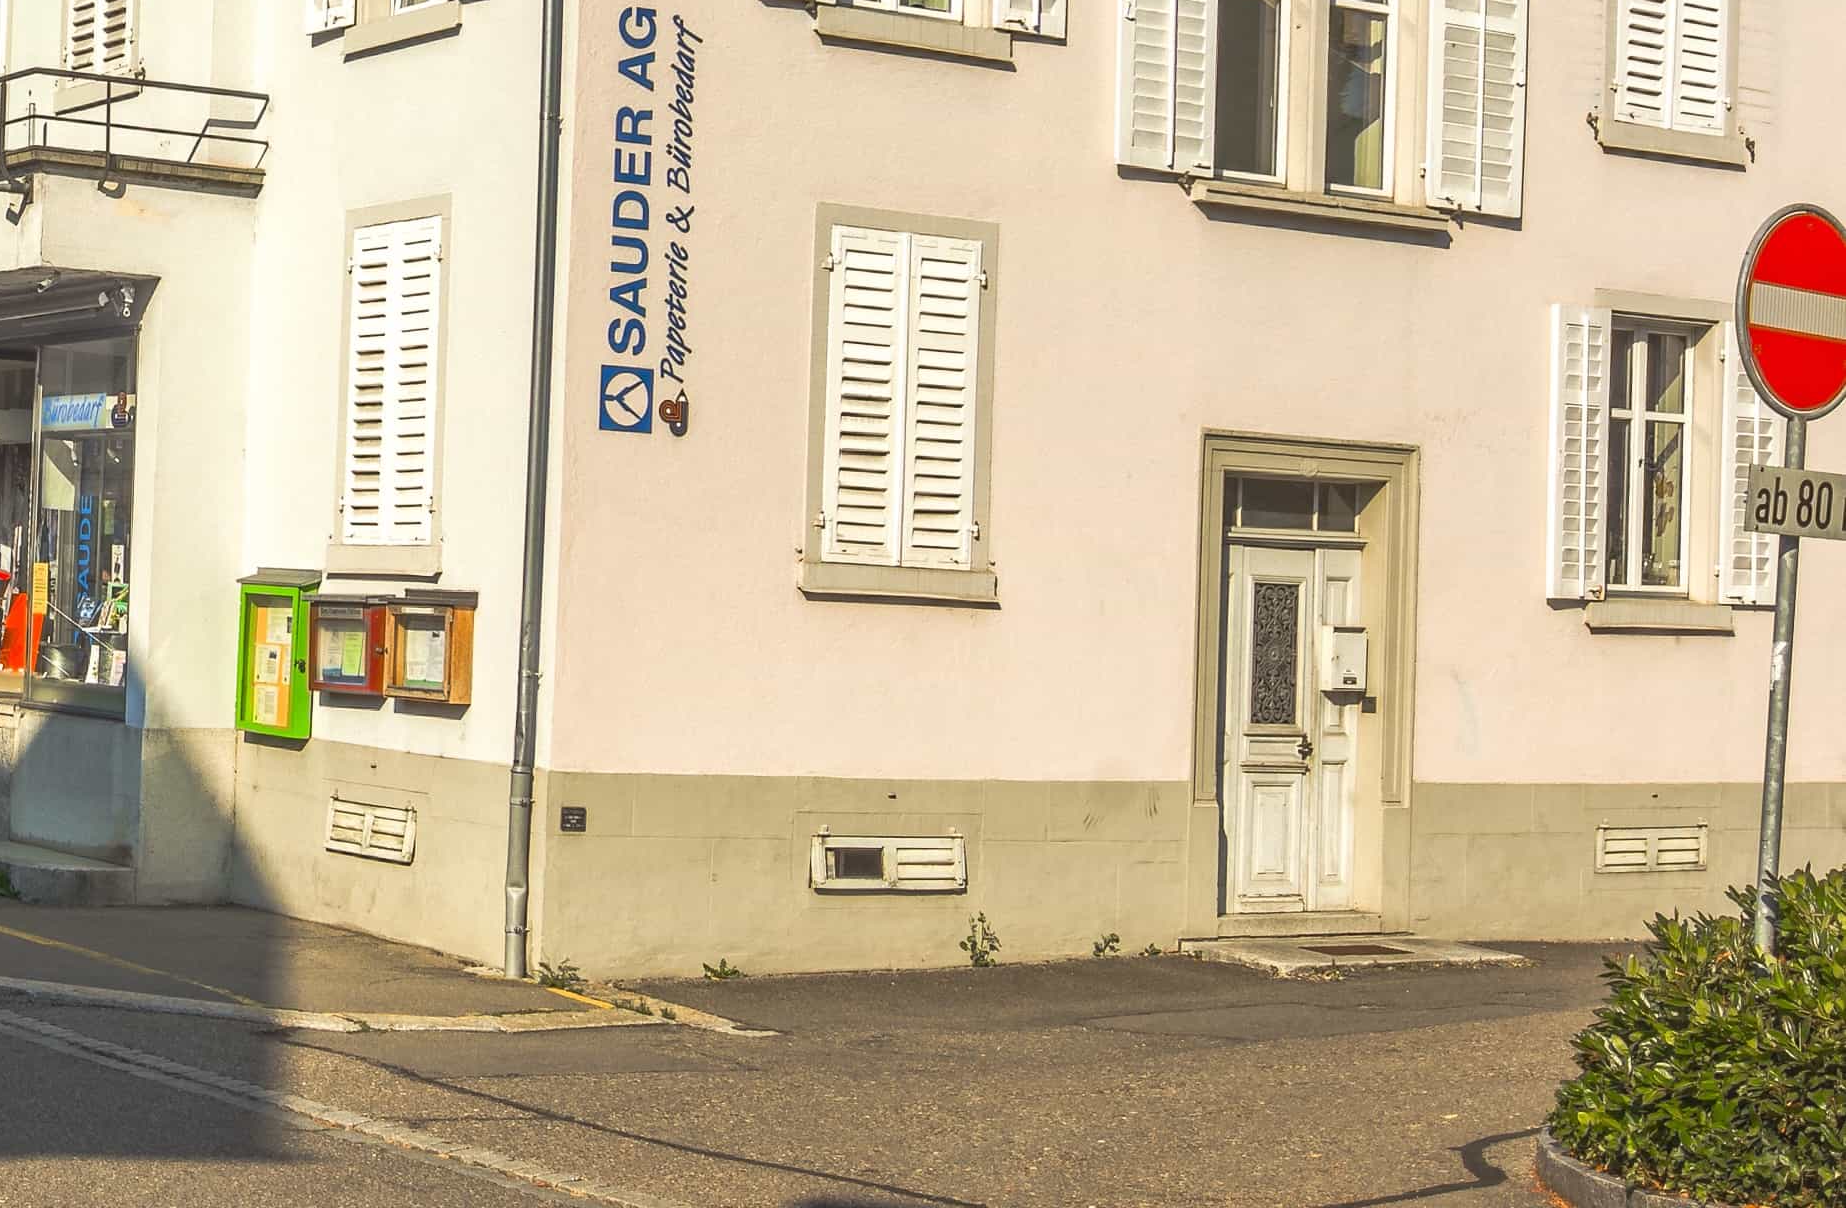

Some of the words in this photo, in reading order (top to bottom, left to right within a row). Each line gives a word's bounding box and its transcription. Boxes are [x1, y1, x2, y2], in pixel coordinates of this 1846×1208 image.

[617, 5, 658, 92] AG
[665, 14, 704, 195] Bürobedarf
[608, 106, 654, 356] SAUDER
[665, 204, 695, 234] &
[659, 241, 694, 384] Papeterie
[1755, 476, 1788, 526] ab
[1796, 479, 1834, 530] 80
